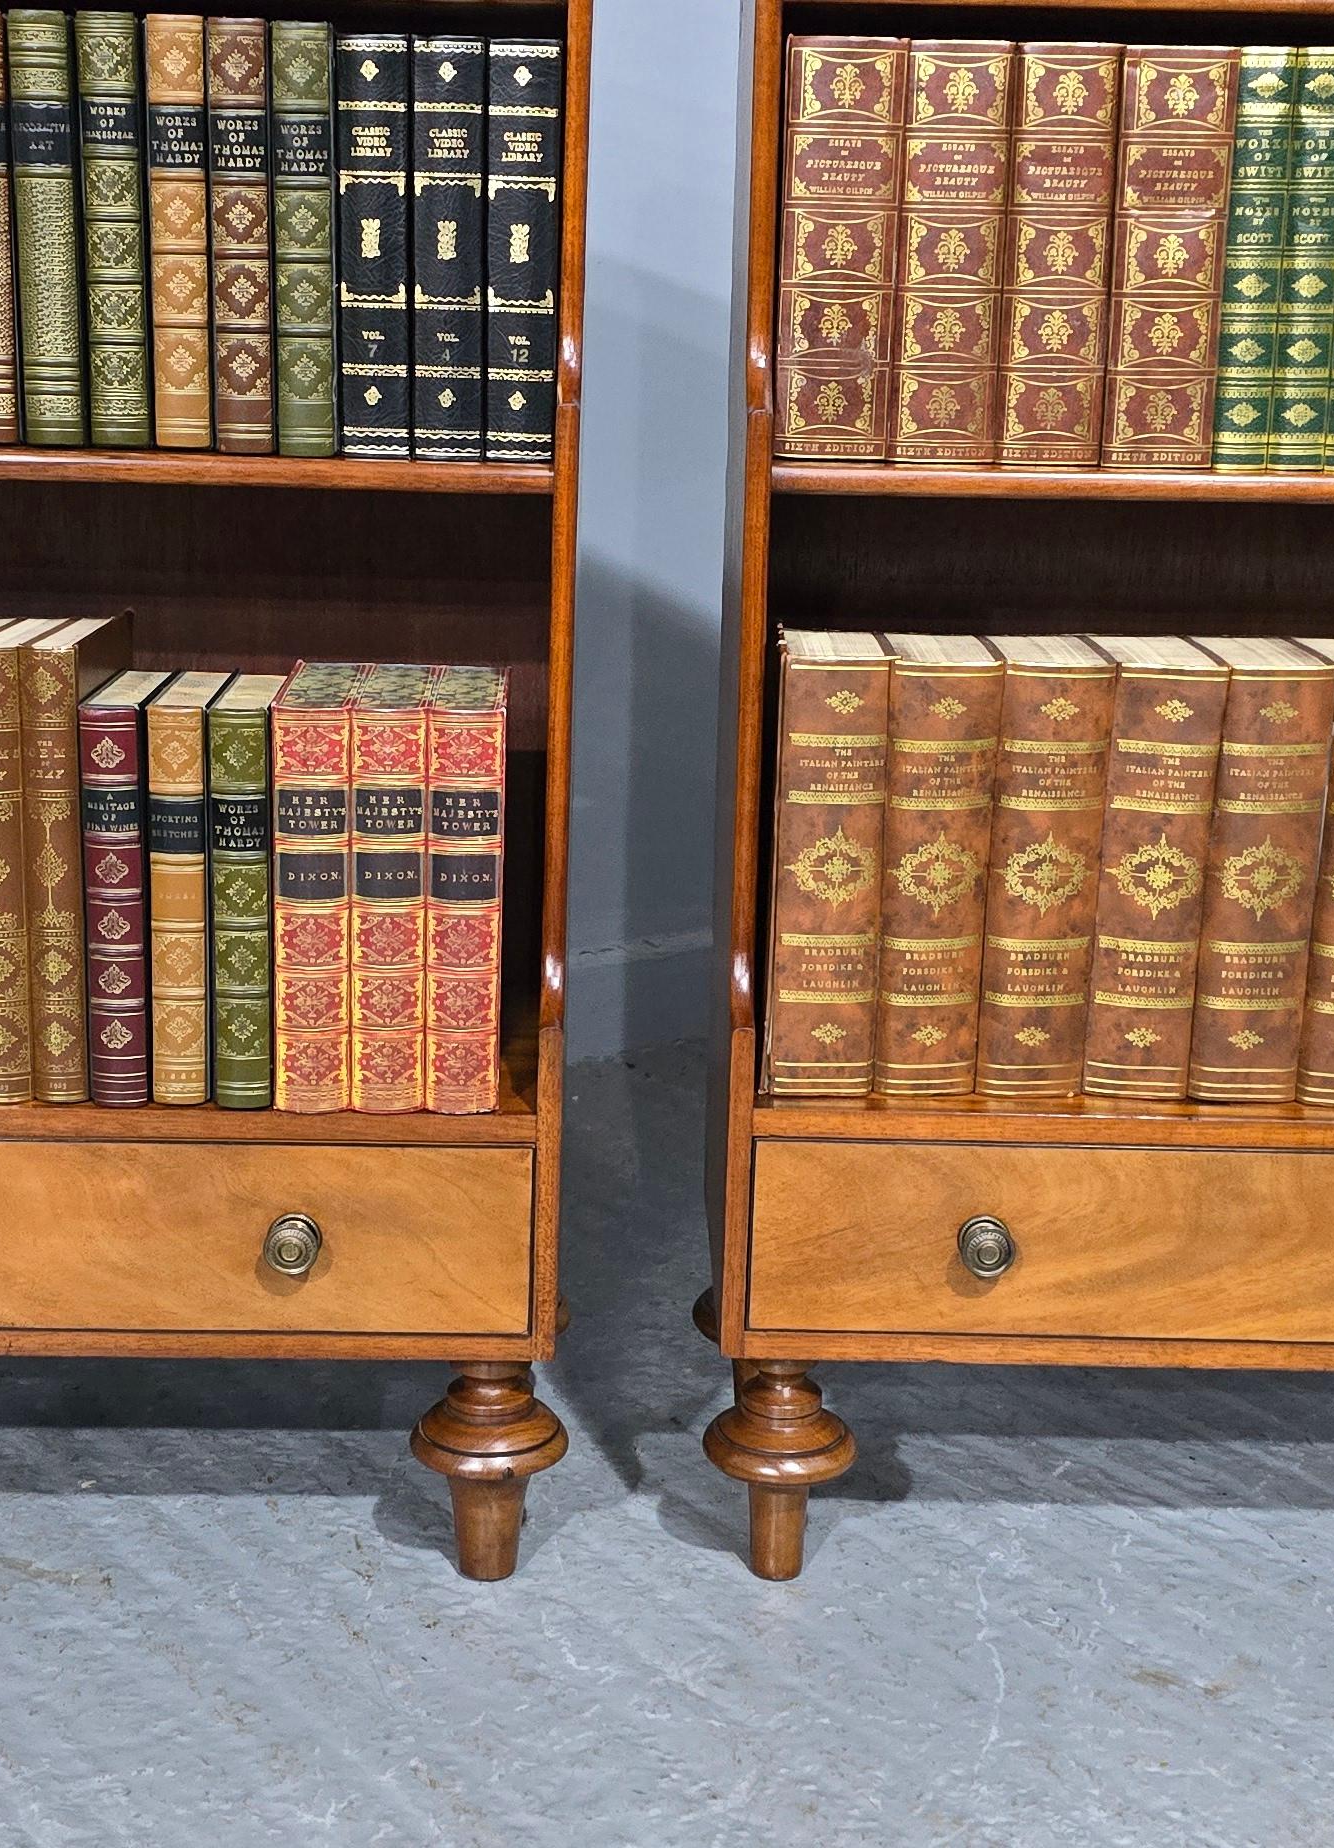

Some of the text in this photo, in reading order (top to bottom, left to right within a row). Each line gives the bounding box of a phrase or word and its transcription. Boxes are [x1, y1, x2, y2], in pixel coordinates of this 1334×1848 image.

[89, 106, 127, 116] WORKS
[100, 118, 115, 128] OF
[155, 116, 197, 127] WORKS
[216, 120, 259, 131] WORKS
[168, 128, 184, 139] OF
[280, 124, 323, 136] WORKS
[351, 126, 391, 137] CLASSIC
[429, 128, 468, 138] CLASSIC
[228, 132, 245, 143] OF
[503, 131, 543, 142] CLASSIC
[152, 141, 203, 151] THOMAS
[292, 137, 309, 148] OF
[356, 137, 387, 147] VIDEO
[433, 138, 465, 148] VIDEO
[507, 142, 539, 152] VIDEO
[828, 138, 862, 148] ESSAYS
[214, 145, 265, 155] THOMAS
[351, 147, 393, 157] LIBRARY
[941, 143, 976, 152] ESSAYS
[156, 153, 200, 164] HARDY
[277, 150, 328, 160] THOMAS
[427, 148, 470, 159] LIBRARY
[501, 152, 543, 163] LIBRARY
[217, 157, 262, 168] HARDY
[280, 162, 325, 172] HARDY
[805, 160, 882, 171] PICTURESQUE
[918, 163, 995, 175] PICTURESQUE
[821, 172, 865, 183] BEAUTY
[934, 177, 978, 187] BEAUTY
[809, 186, 873, 195] WILLIAM GILPIN
[923, 190, 987, 199] WILLIAM GILPIN
[1293, 233, 1331, 244] SCOTT
[368, 344, 378, 358] 7
[441, 349, 451, 362] 4
[510, 349, 529, 363] 12
[785, 442, 875, 453] SIXTH EDITION
[834, 748, 852, 757] THE
[799, 759, 885, 768] ITALIAN PAINTERS
[826, 771, 859, 780] OF THE
[809, 783, 874, 792] RENAISSANCE
[292, 796, 329, 805] HER
[369, 796, 405, 805] HER
[445, 798, 481, 806] HER
[87, 801, 136, 811] HERITAGE
[218, 804, 259, 814] WORKS
[356, 806, 423, 816] MAJESTY'S
[279, 807, 347, 817] MAJESTY'S
[433, 809, 499, 819] MAJESTY'S
[102, 813, 117, 822] OF
[151, 814, 199, 823] SPORTING
[230, 816, 246, 825] OF
[110, 822, 139, 832] WINES
[288, 819, 339, 830] TOWER
[365, 819, 415, 830] TOWER
[441, 821, 491, 832] TOWER
[214, 825, 265, 836] THOMAS
[218, 837, 262, 848] HARDY
[287, 871, 342, 881] DIXON.
[364, 870, 418, 880] DIXON.
[440, 872, 494, 883] DIXON.
[804, 948, 865, 957] BRADBURN
[801, 963, 853, 972] FORSDIKE
[802, 979, 859, 988] LAUGHLIN
